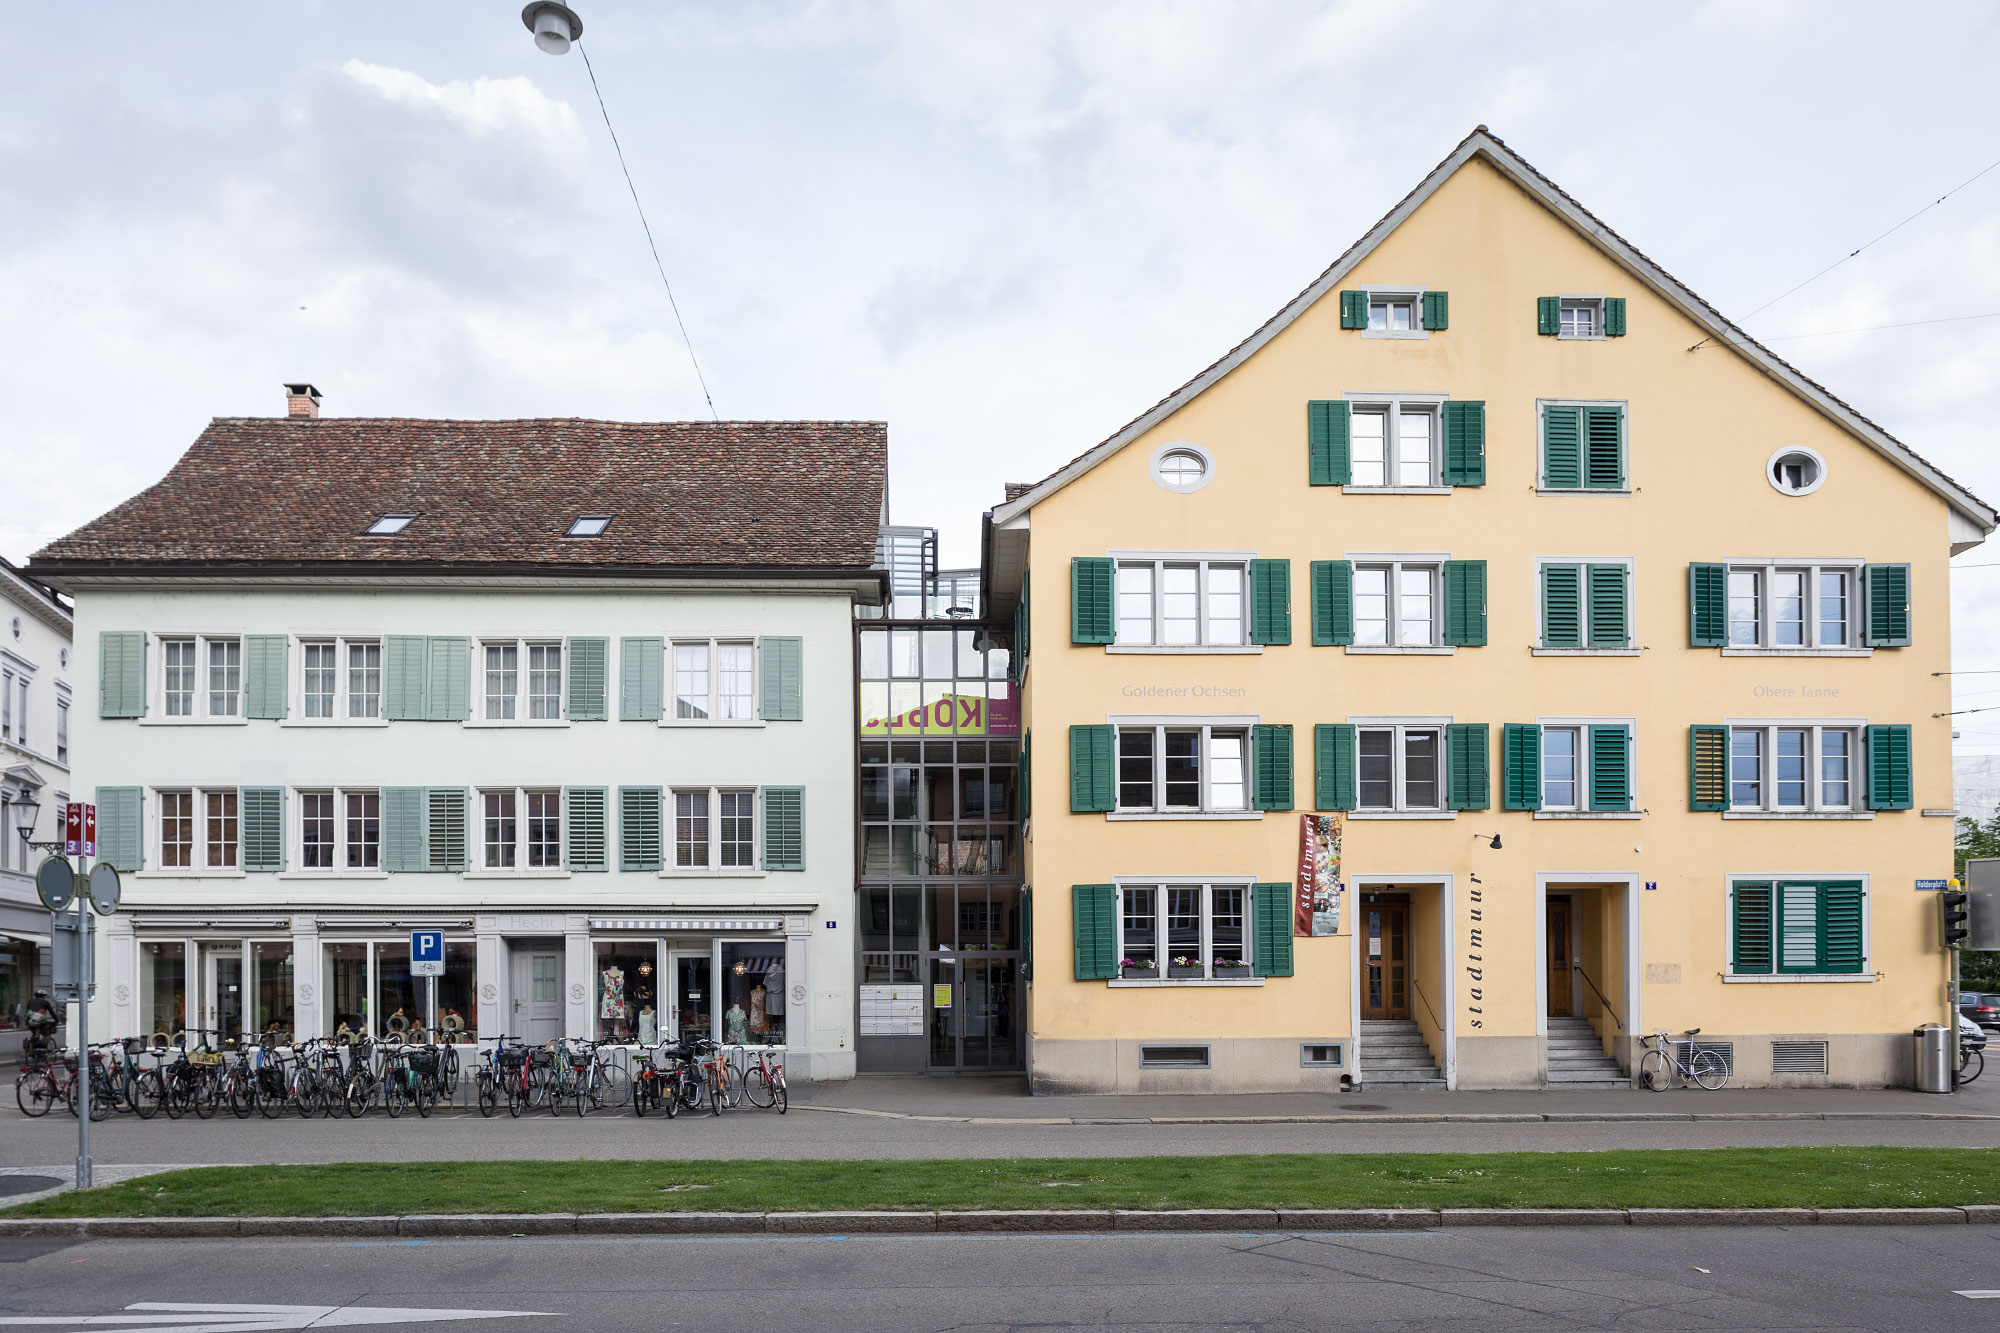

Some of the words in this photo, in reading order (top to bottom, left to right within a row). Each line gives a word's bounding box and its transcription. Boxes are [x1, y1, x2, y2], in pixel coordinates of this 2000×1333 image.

[1121, 685, 1188, 697] Goldener
[1192, 685, 1246, 697] Ochsen
[1753, 685, 1796, 698] Obere
[1800, 685, 1840, 698] Tanne
[1301, 817, 1314, 909] stadtmuur
[510, 915, 555, 929] Hecht
[420, 935, 434, 955] P
[1466, 872, 1483, 1029] stadtmuur
